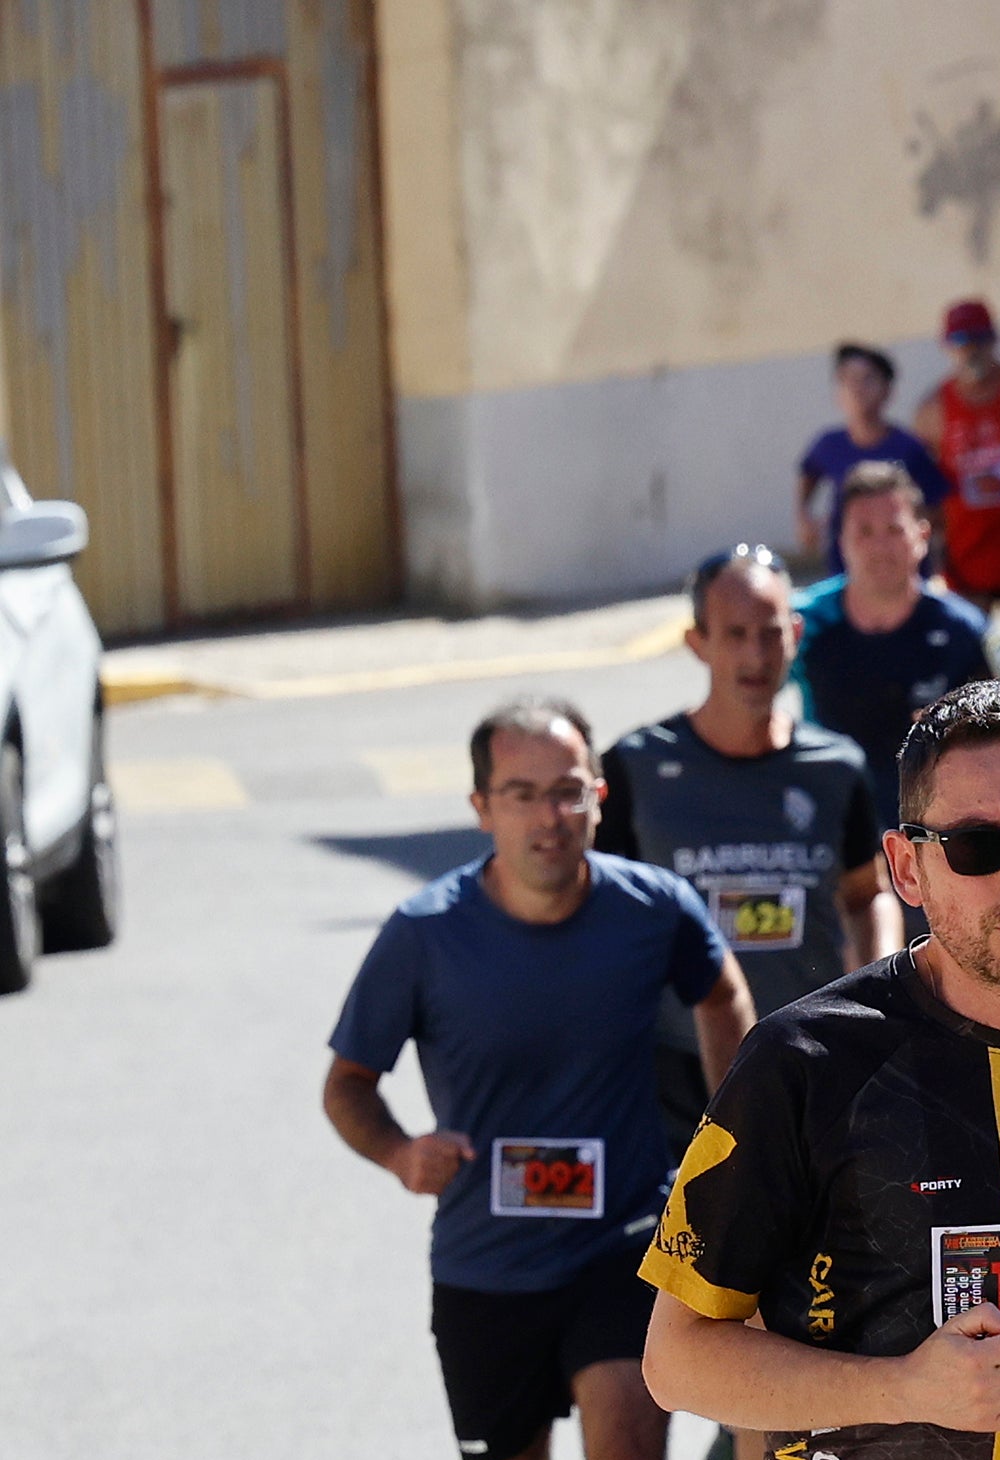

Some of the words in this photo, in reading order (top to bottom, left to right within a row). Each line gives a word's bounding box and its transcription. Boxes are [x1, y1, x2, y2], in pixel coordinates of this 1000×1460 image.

[525, 1160, 594, 1194] 092
[910, 1178, 962, 1194] SPORTY
[957, 1276, 970, 1288] de
[970, 1268, 984, 1304] crónica
